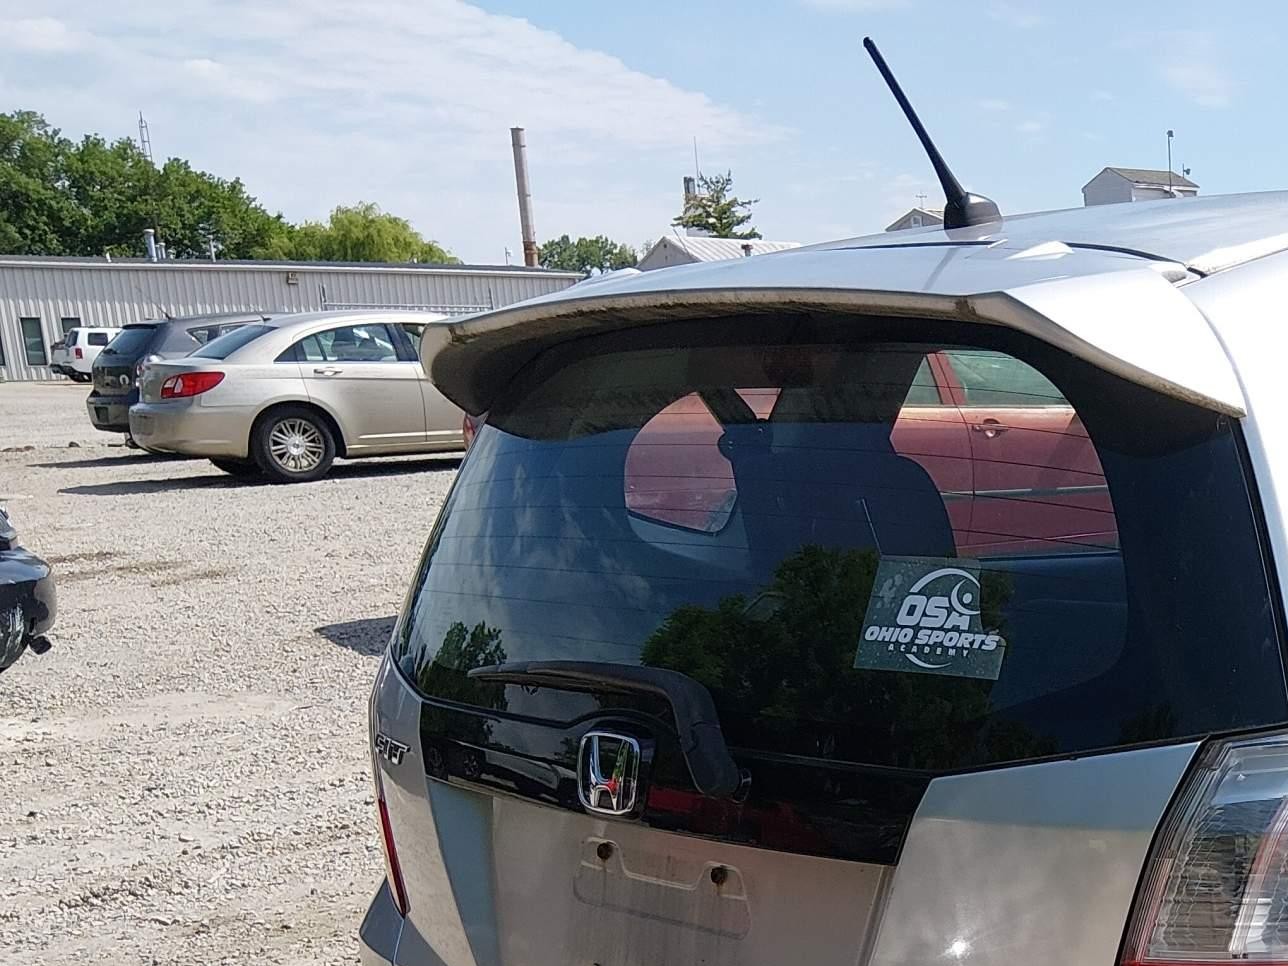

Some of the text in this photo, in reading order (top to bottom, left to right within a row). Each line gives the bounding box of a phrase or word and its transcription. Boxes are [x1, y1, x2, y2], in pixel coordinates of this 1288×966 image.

[896, 594, 970, 631] OSA
[864, 625, 1001, 651] OHIO SPORTS
[887, 644, 969, 657] ACADEMY
